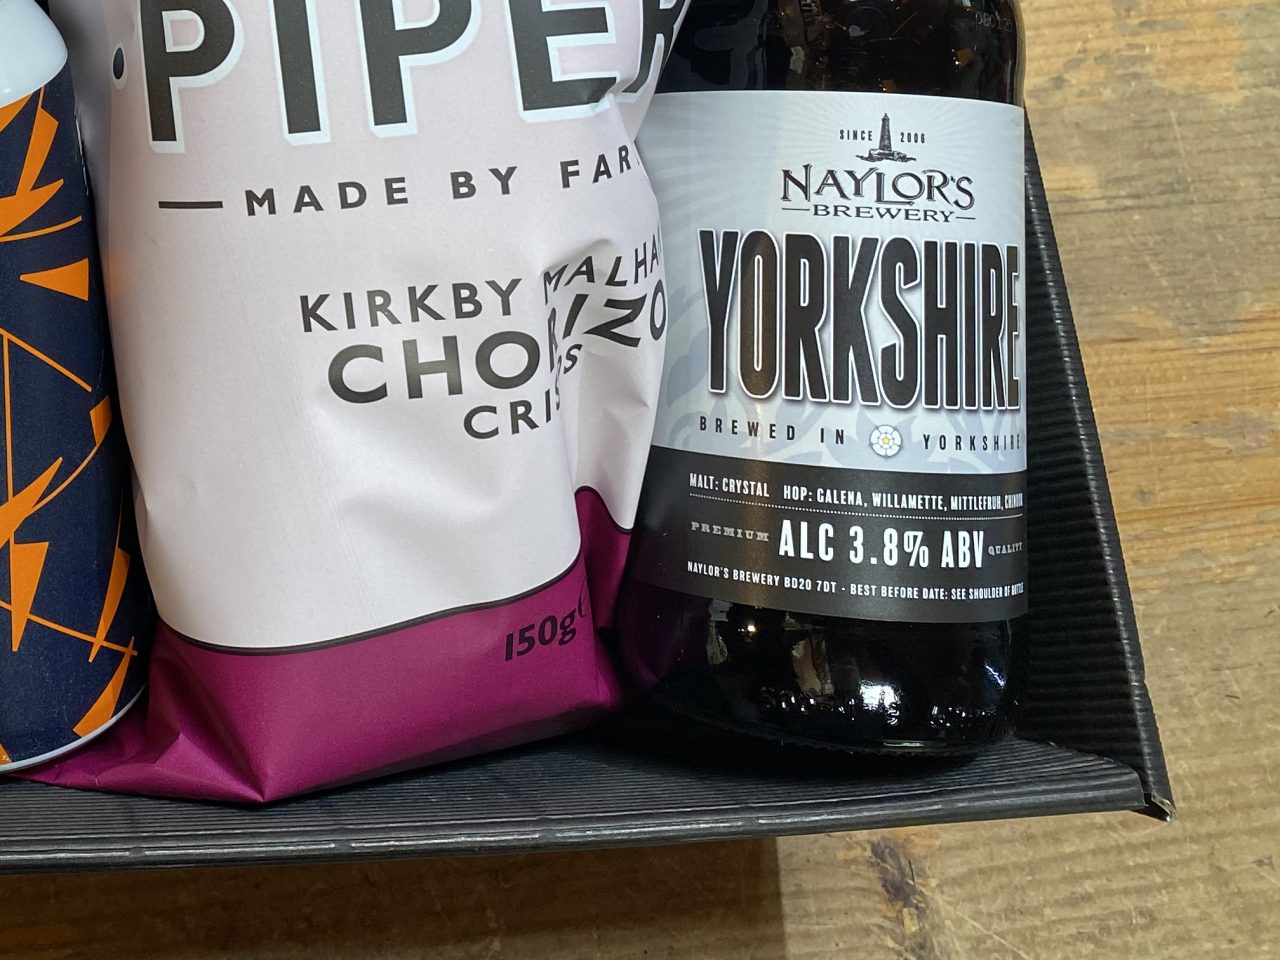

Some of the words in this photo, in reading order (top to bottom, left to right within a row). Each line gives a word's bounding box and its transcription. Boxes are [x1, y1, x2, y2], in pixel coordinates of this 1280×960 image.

[839, 129, 873, 142] SINCE
[245, 176, 409, 218] MADE
[450, 166, 519, 200] BY
[560, 144, 639, 190] FAR
[780, 163, 976, 211] NAYLOR'S
[812, 204, 955, 223] BREWERY
[300, 278, 522, 333] KIRKBY
[542, 232, 663, 307] MALHA
[327, 278, 667, 404] CHORIZO
[697, 228, 1021, 411] YORKSHIRE
[699, 415, 796, 441] BREWED
[820, 427, 845, 445] IN
[922, 433, 1021, 452] YORKSHIRE
[689, 472, 719, 491] MALT:
[722, 477, 770, 498] CRYSTAL
[783, 484, 813, 502] HOP:
[816, 488, 868, 508] GALENA,
[872, 492, 948, 512] WILLAMETTE,
[690, 521, 770, 542] PREMIUM
[779, 519, 835, 562] ALC
[849, 525, 929, 568] 3.8%
[940, 530, 984, 568] ABV
[987, 541, 1023, 556] QUALITY
[687, 560, 729, 579] NAYLOR'S
[732, 569, 780, 587] BREWERY
[784, 576, 812, 591] BD20
[816, 580, 837, 593] 7DT
[850, 583, 877, 597] BEST
[880, 585, 919, 600] BEFORE
[922, 587, 948, 600] DATE:
[951, 587, 966, 601] SEE
[968, 585, 1003, 600] SHOULDER
[504, 607, 577, 662] 150g
